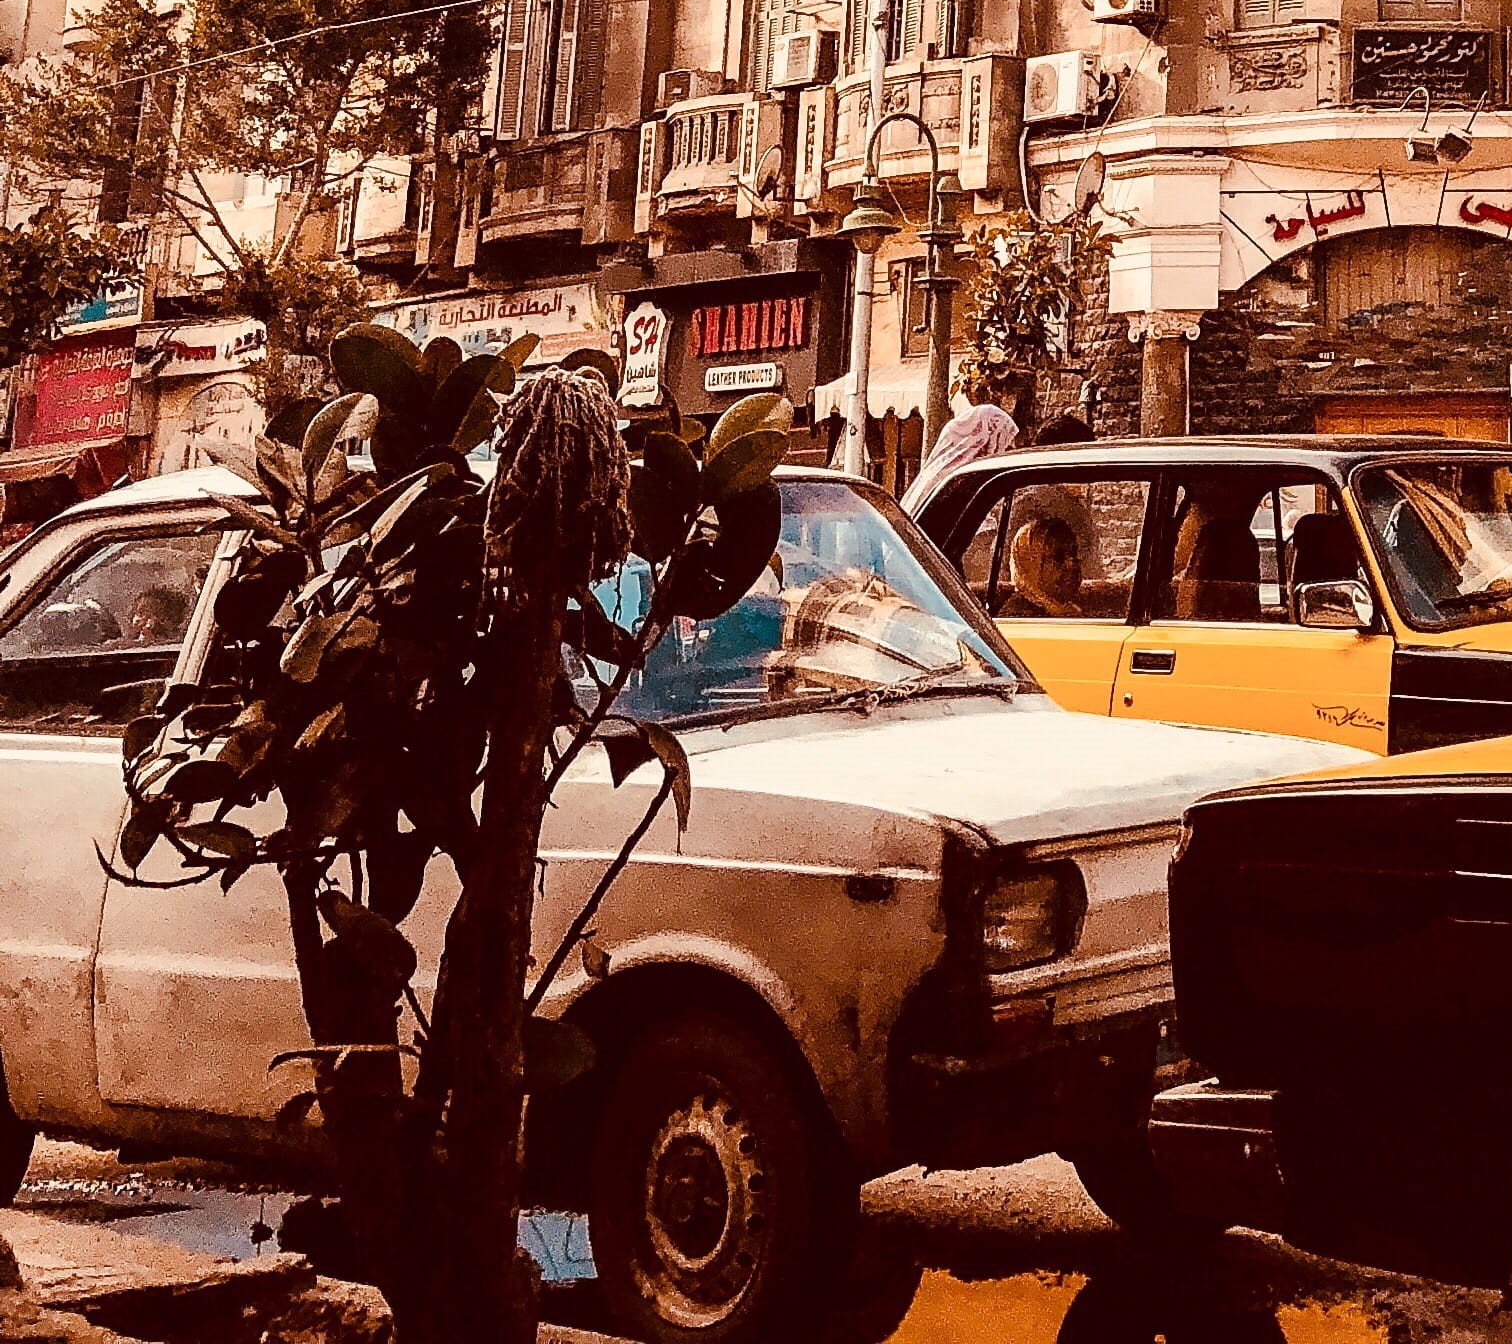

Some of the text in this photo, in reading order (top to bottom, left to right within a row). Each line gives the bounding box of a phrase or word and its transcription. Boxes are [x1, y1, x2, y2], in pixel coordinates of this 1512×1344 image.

[1264, 189, 1366, 242] للسياحة
[438, 293, 562, 329] المطبعة التجارية
[689, 296, 806, 356] SHAHIEN
[626, 362, 657, 384] شاهين
[707, 367, 774, 387] LEATHER PRODUCTS
